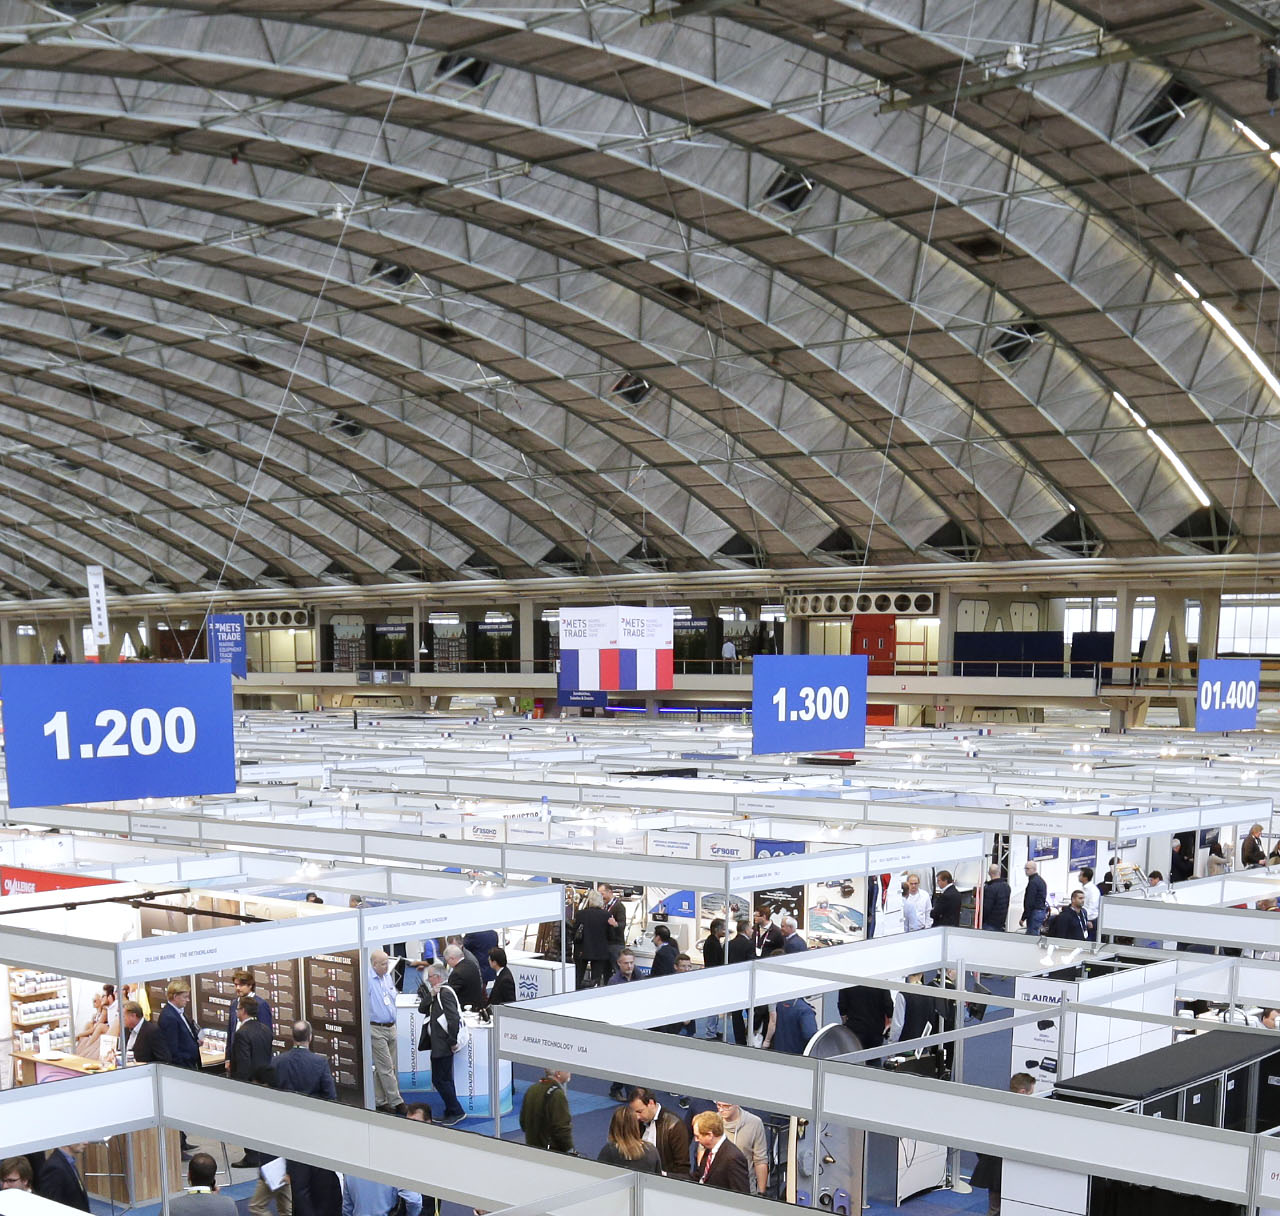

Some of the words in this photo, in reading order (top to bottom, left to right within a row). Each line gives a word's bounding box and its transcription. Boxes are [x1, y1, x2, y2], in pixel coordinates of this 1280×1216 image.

[219, 623, 241, 633] METS
[566, 619, 587, 628] METS
[625, 618, 645, 628] METS
[217, 632, 242, 641] TRADE
[564, 629, 588, 638] TRADE
[623, 628, 645, 638] TRADE
[1200, 680, 1256, 711] 01.400
[772, 685, 850, 723] 1.300
[44, 706, 197, 761] 1.200
[520, 974, 538, 983] MAVI
[1032, 994, 1071, 1005] AIRMA
[523, 1036, 542, 1045] AIRMAR
[542, 1039, 574, 1051] TECHNOLOGY
